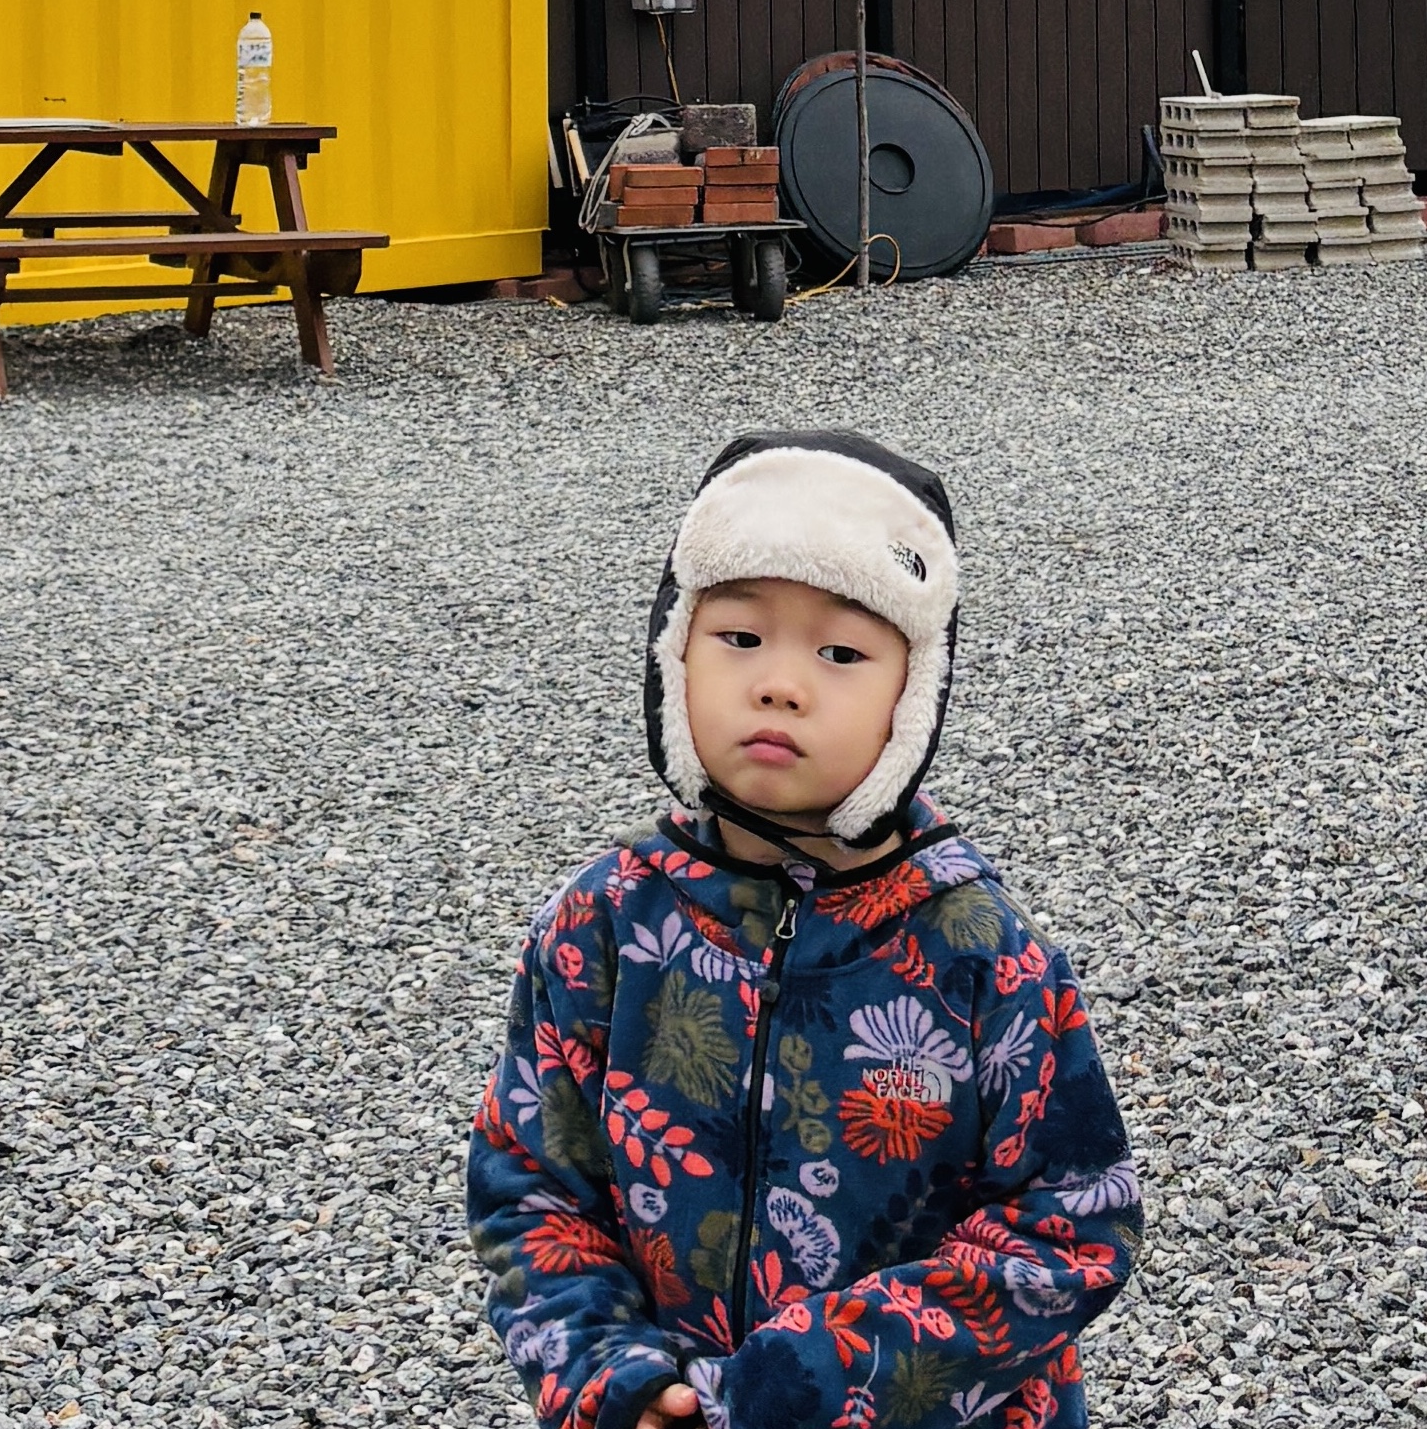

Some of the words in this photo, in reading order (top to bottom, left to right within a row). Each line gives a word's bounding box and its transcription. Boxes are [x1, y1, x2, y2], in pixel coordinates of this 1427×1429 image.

[891, 1057, 922, 1071] THE
[863, 1068, 924, 1086] NORTH
[876, 1083, 921, 1099] FACE
